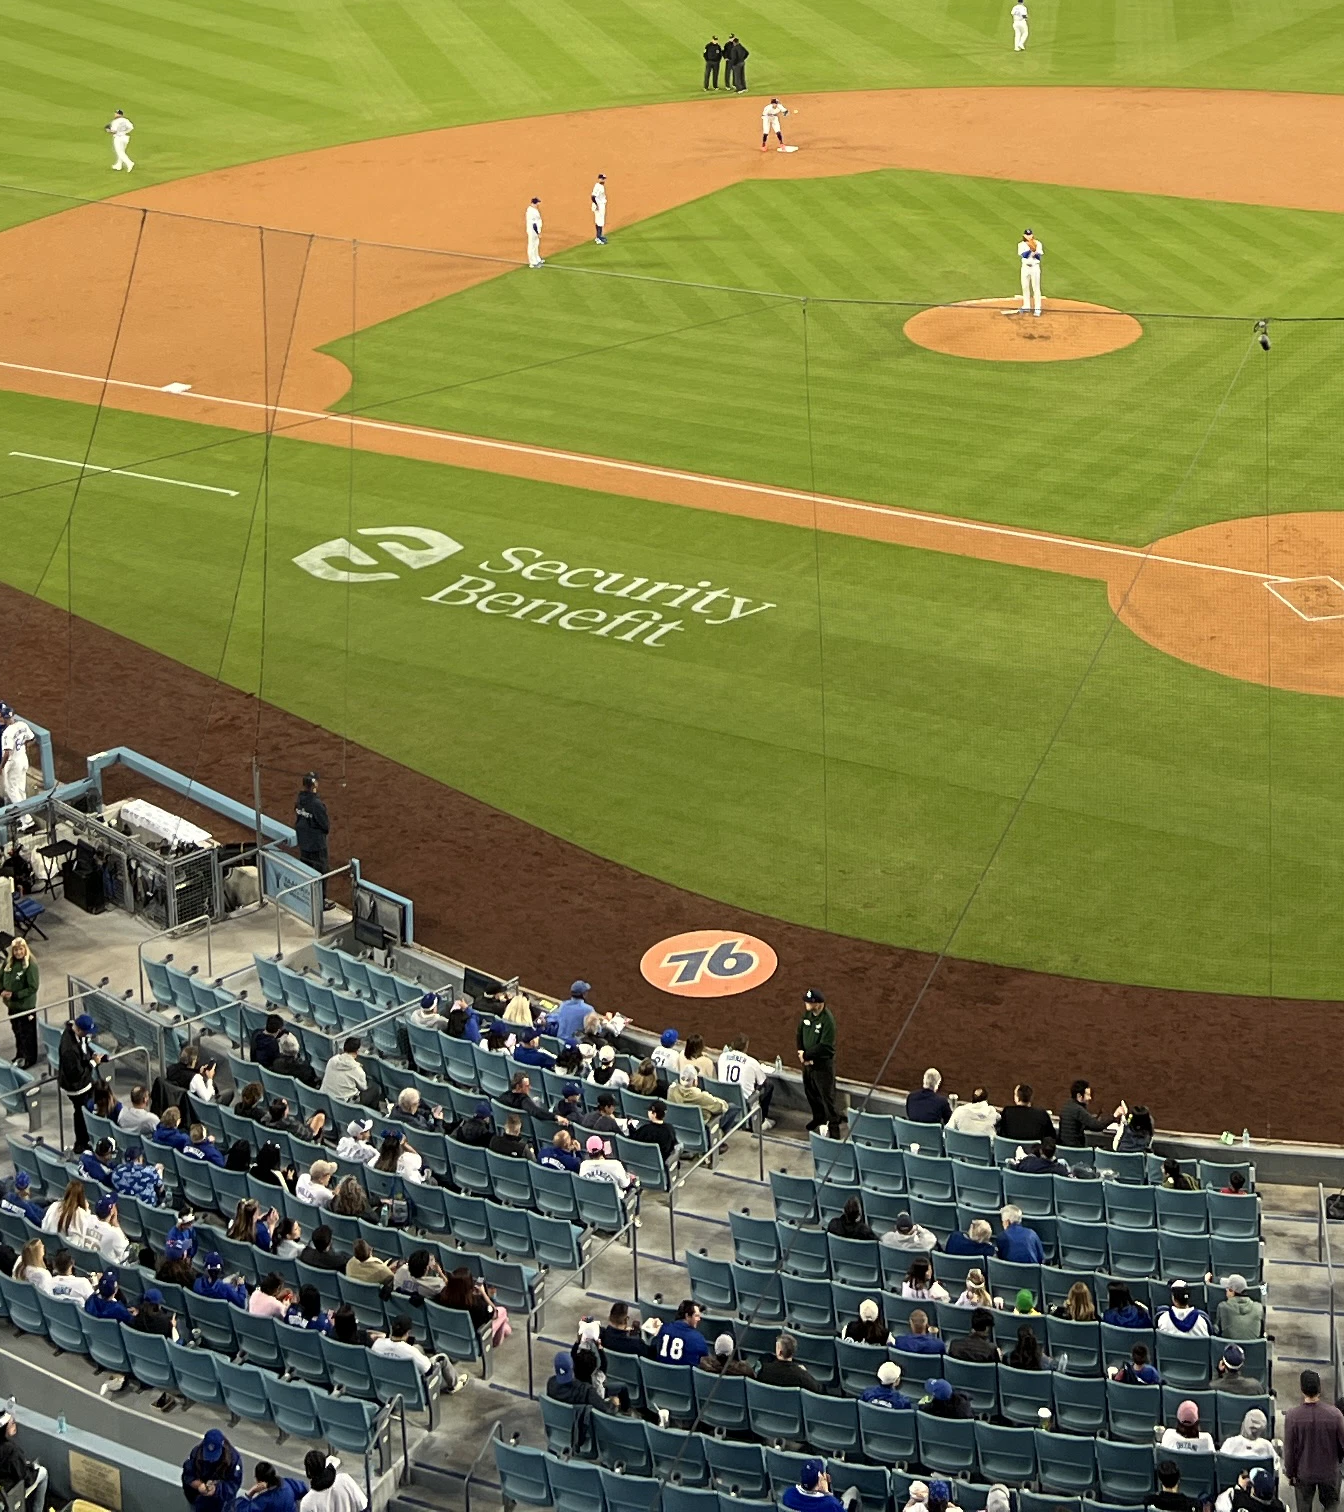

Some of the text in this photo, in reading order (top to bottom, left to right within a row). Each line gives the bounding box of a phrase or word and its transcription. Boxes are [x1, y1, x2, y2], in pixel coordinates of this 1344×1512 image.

[478, 546, 777, 624] Security
[422, 574, 685, 647] Benefit
[659, 938, 760, 987] 76
[726, 1064, 741, 1083] 10
[659, 1333, 684, 1360] 18
